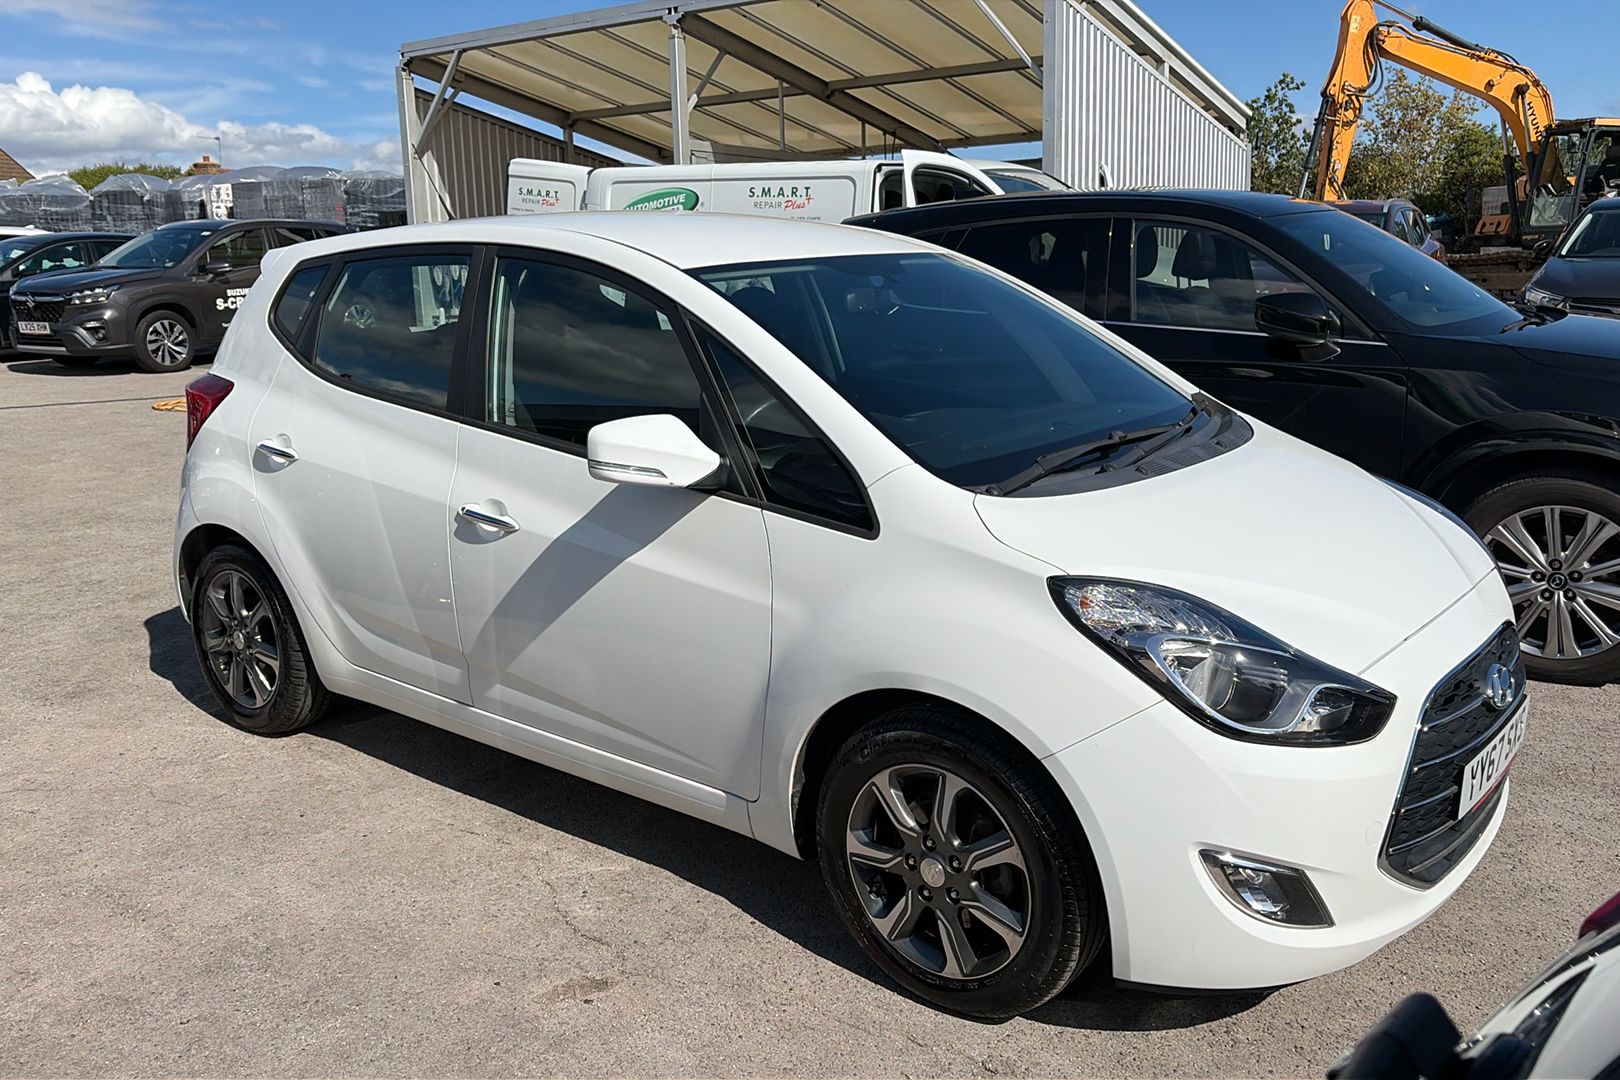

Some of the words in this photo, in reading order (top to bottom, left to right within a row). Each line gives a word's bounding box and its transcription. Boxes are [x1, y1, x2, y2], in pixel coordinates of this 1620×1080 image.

[753, 201, 783, 209] REPAIR
[226, 288, 251, 296] SUZUK
[1469, 732, 1506, 802] YY67
